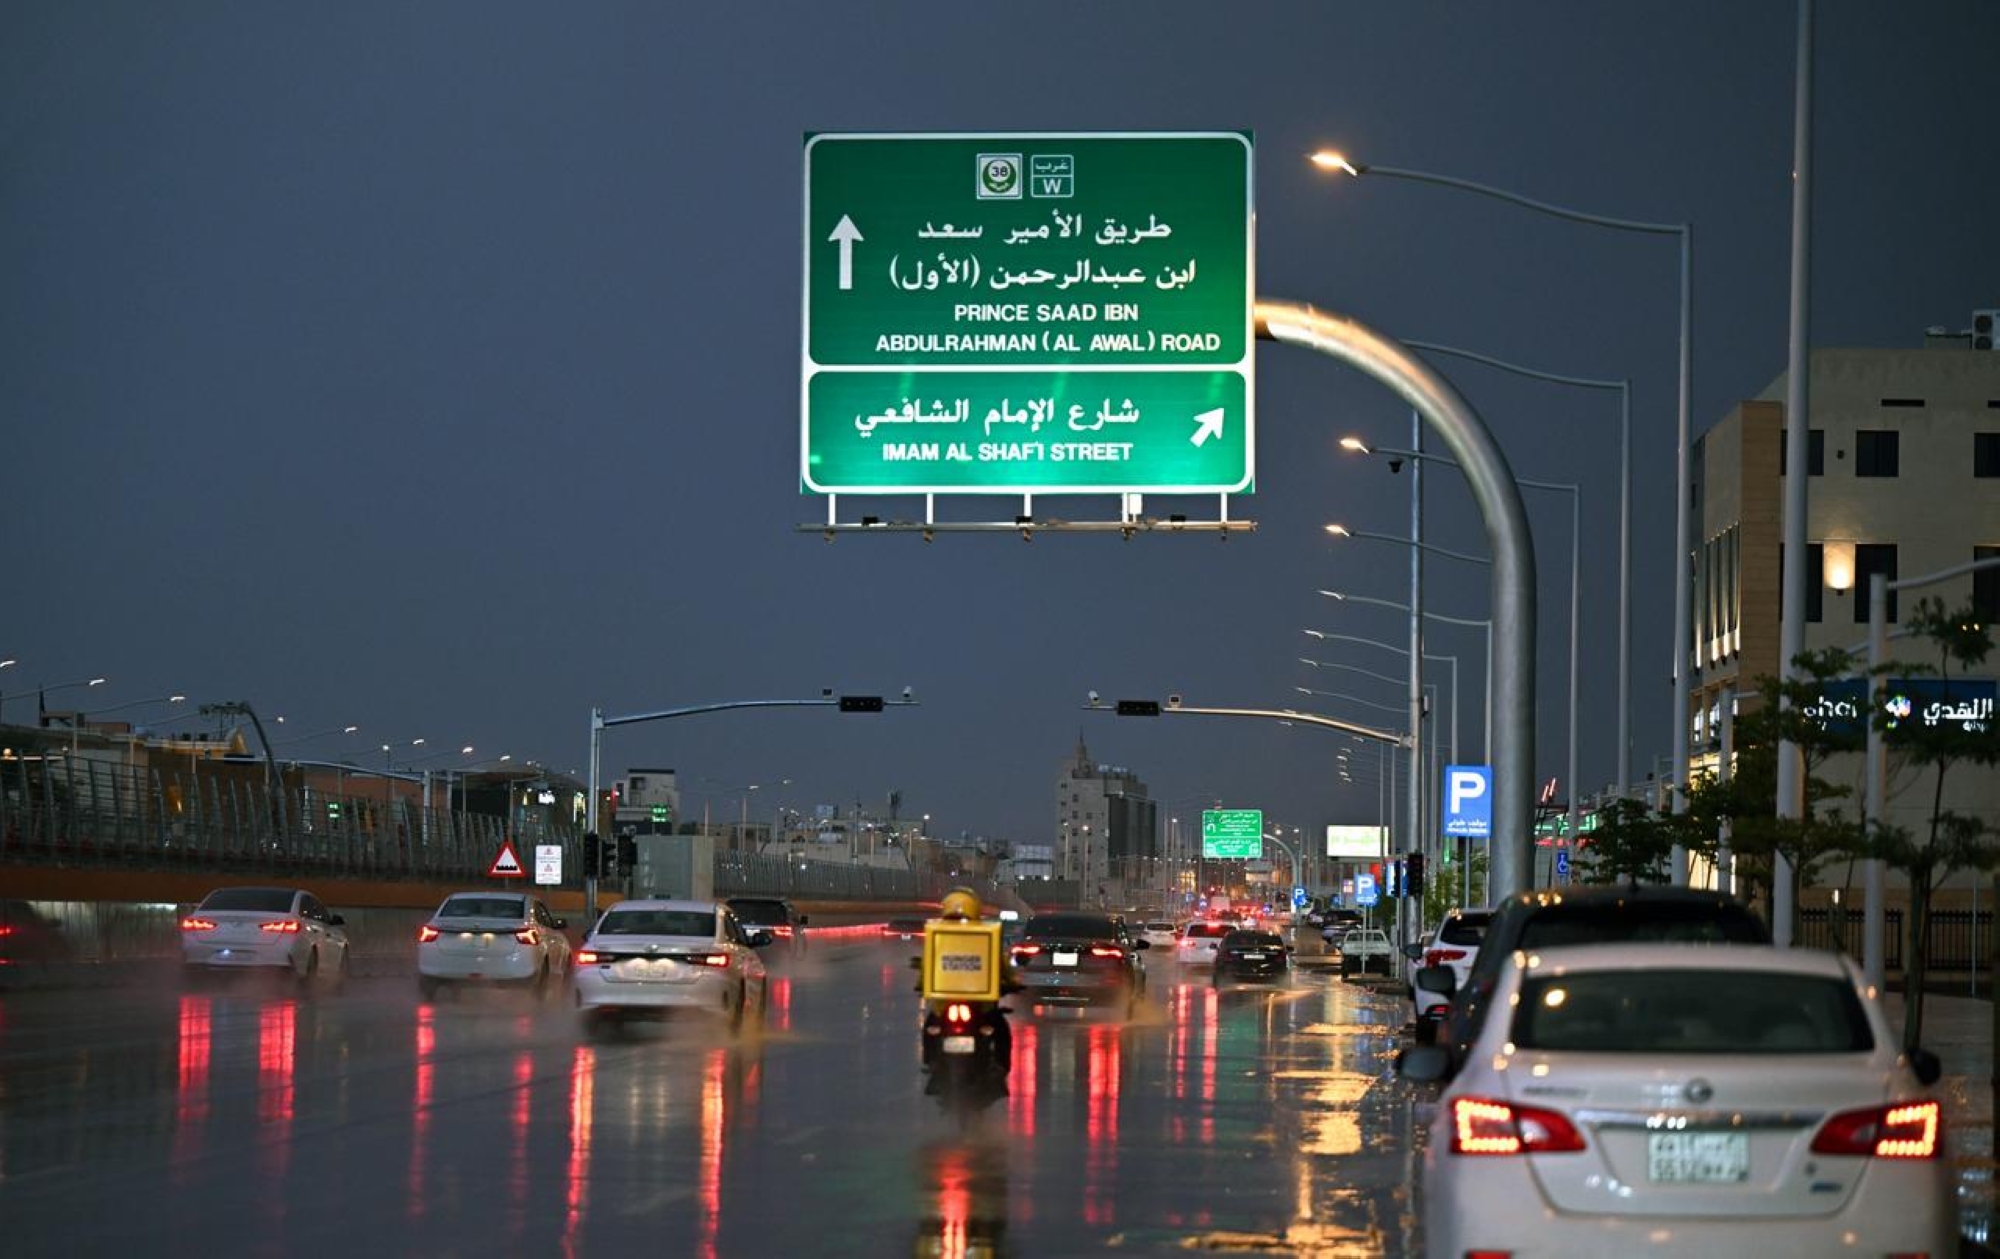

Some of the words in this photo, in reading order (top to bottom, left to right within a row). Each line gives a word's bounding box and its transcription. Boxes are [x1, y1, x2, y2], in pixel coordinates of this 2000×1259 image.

[991, 165, 1009, 178] 38
[1035, 159, 1069, 173] غرب
[1043, 178, 1062, 194] W
[919, 223, 982, 238] سعد
[1004, 209, 1081, 244] الأمير
[1096, 214, 1171, 244] طريق
[890, 253, 980, 290] (الأول)
[990, 259, 1146, 289] عبدالرحمن
[1156, 260, 1195, 289] ابن
[955, 305, 1029, 321] PRINCE
[1037, 304, 1096, 321] SAAD
[1105, 304, 1138, 321] IBN
[876, 335, 1036, 351] ABDULRAHMAN
[1161, 333, 1220, 352] ROAD
[855, 399, 969, 437] الشافعي
[985, 399, 1054, 435] الإمام
[1069, 399, 1139, 430] شارع
[883, 444, 939, 460] IMAM
[946, 443, 972, 461] AL
[1051, 443, 1133, 461] STREET
[1450, 771, 1486, 814] P
[1357, 877, 1374, 895] P
